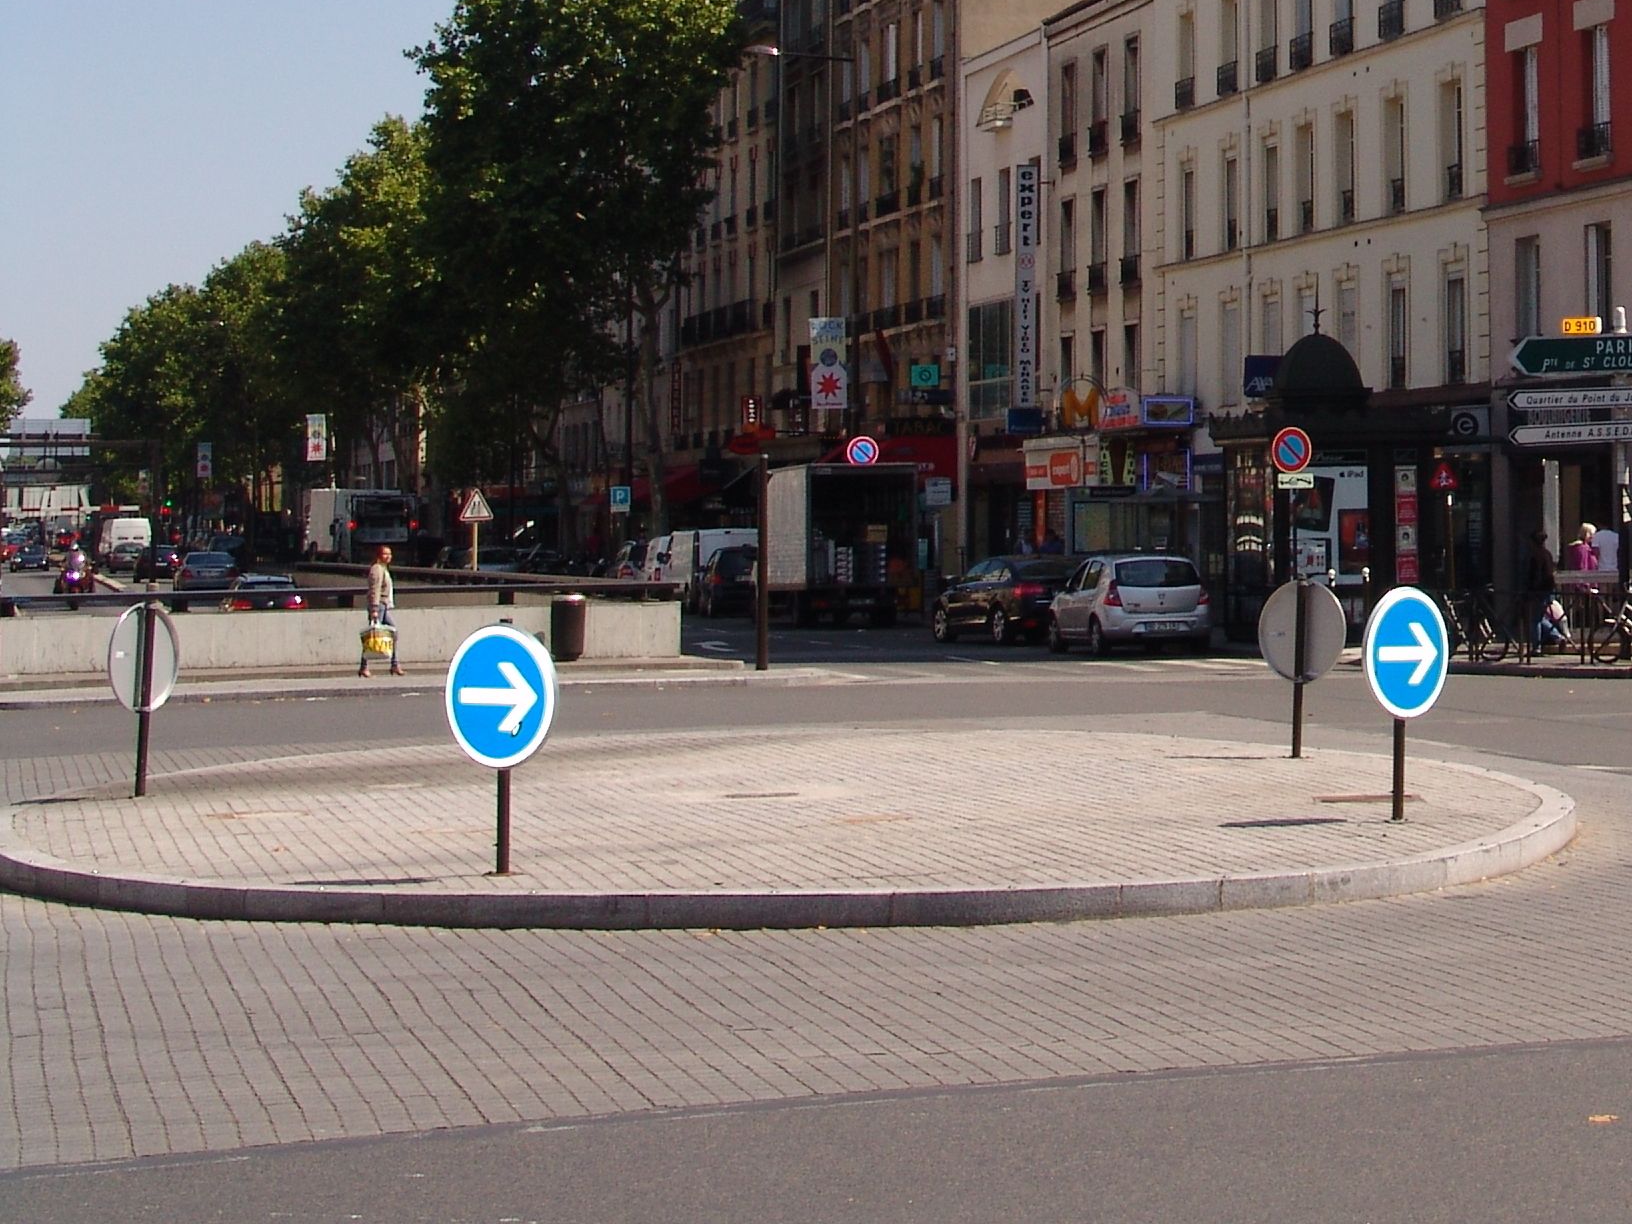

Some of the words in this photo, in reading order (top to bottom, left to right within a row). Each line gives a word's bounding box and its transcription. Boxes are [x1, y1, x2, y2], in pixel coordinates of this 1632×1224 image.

[1019, 170, 1034, 247] expert
[1564, 320, 1571, 332] D
[1575, 320, 1596, 332] 910
[1245, 376, 1273, 392] AXA
[1526, 394, 1563, 405] Quartier
[1568, 395, 1578, 404] du
[1582, 393, 1605, 403] Point
[1610, 393, 1621, 402] du
[1545, 427, 1582, 438] Antenne
[1347, 470, 1364, 478] iPad
